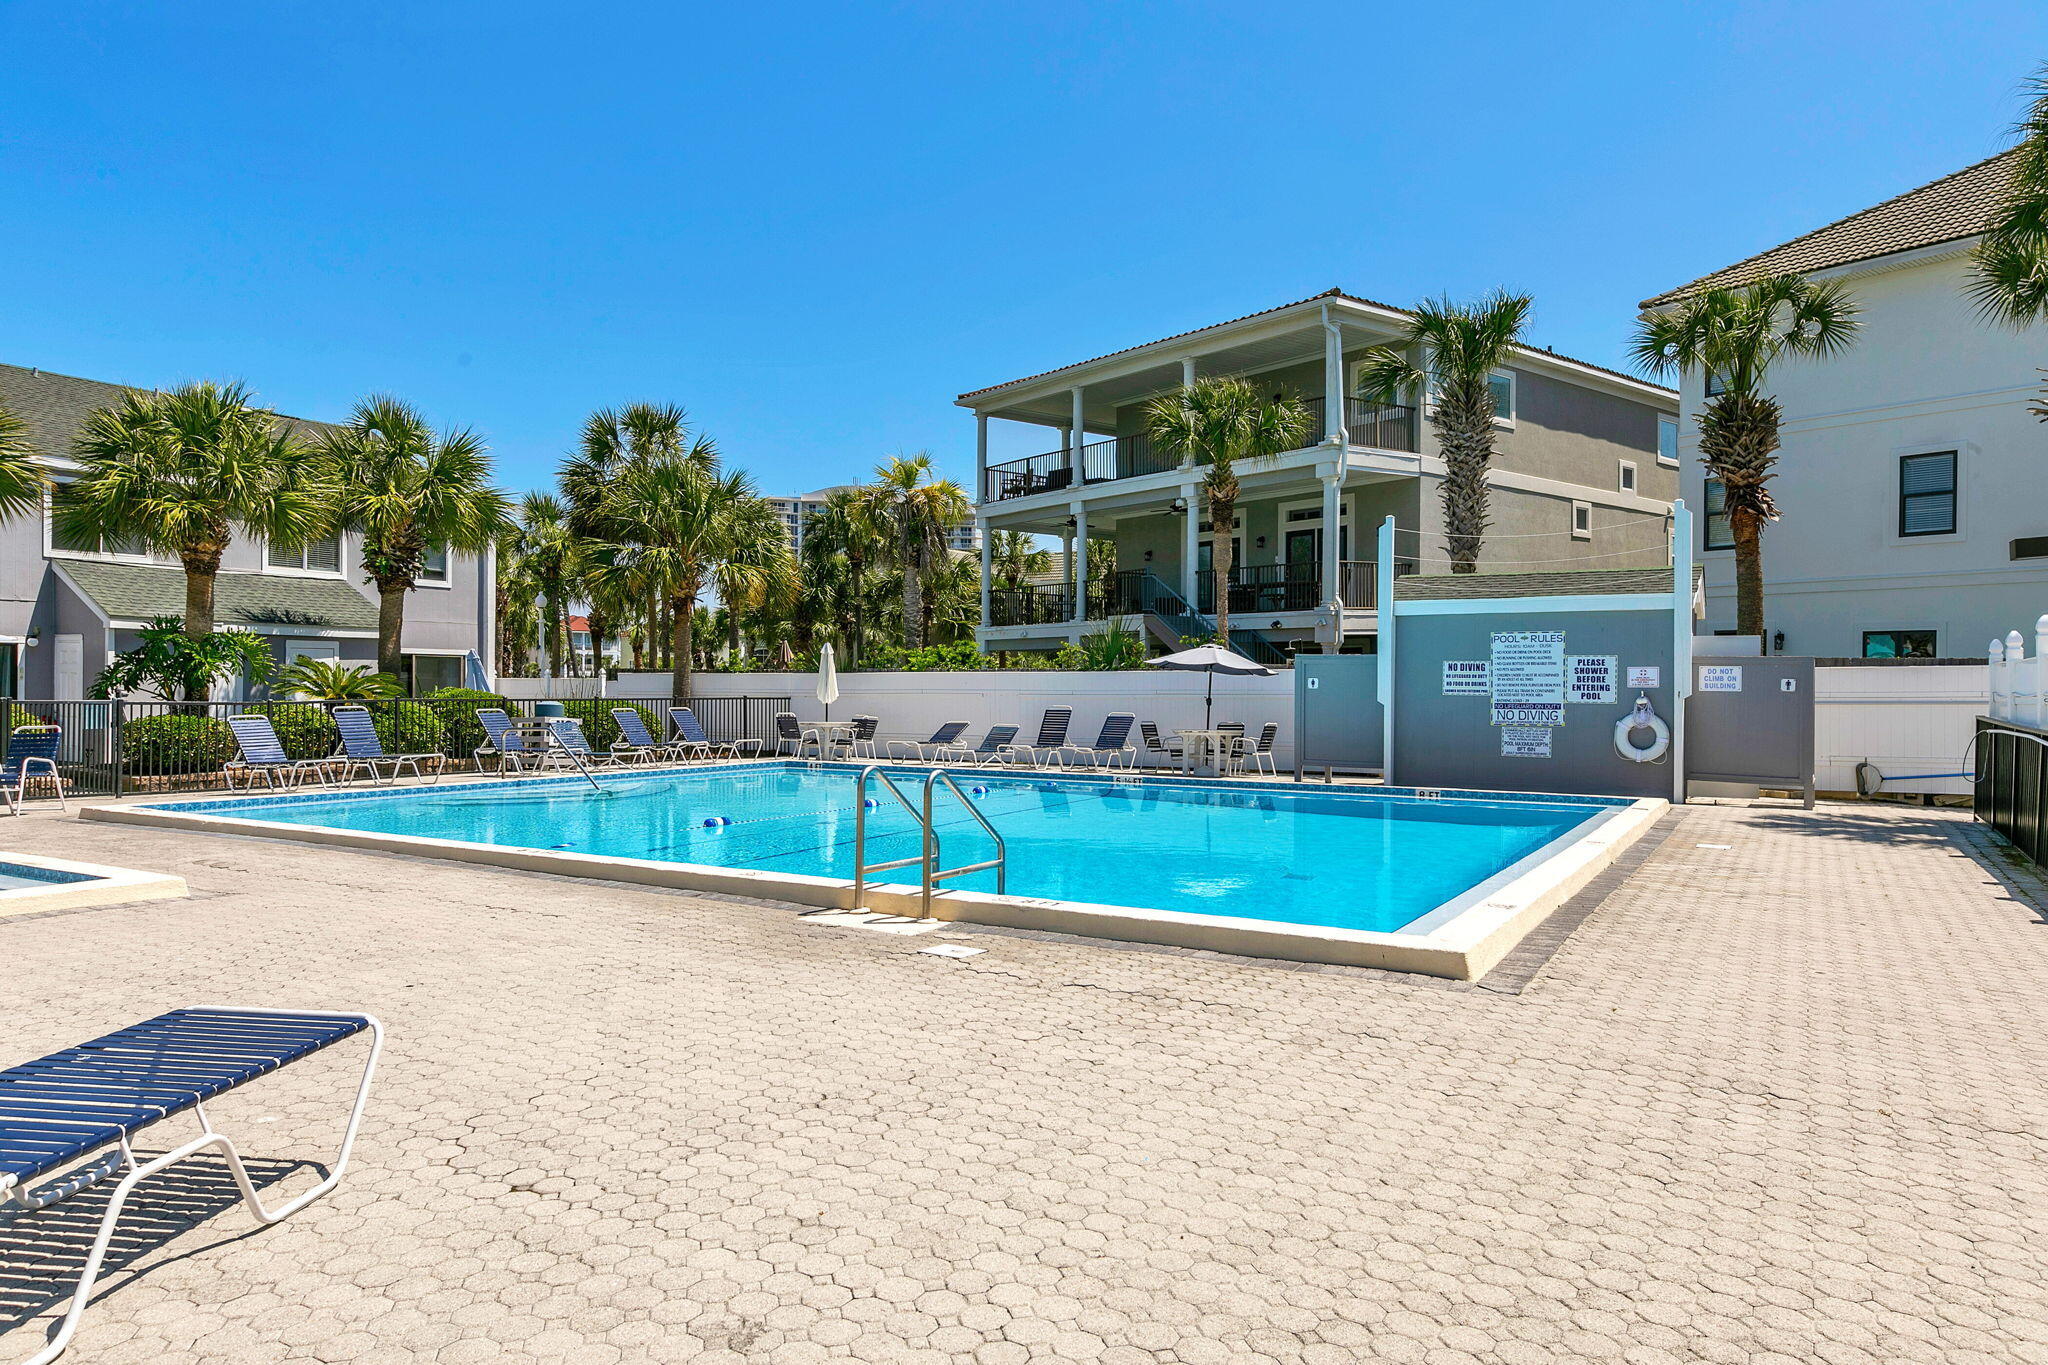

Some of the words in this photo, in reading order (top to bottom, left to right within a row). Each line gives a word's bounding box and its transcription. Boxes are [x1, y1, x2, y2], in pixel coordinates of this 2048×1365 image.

[1448, 663, 1458, 671] NO
[1460, 663, 1486, 671] DIVING
[1497, 710, 1514, 720] NO
[1519, 710, 1558, 720] DIVING
